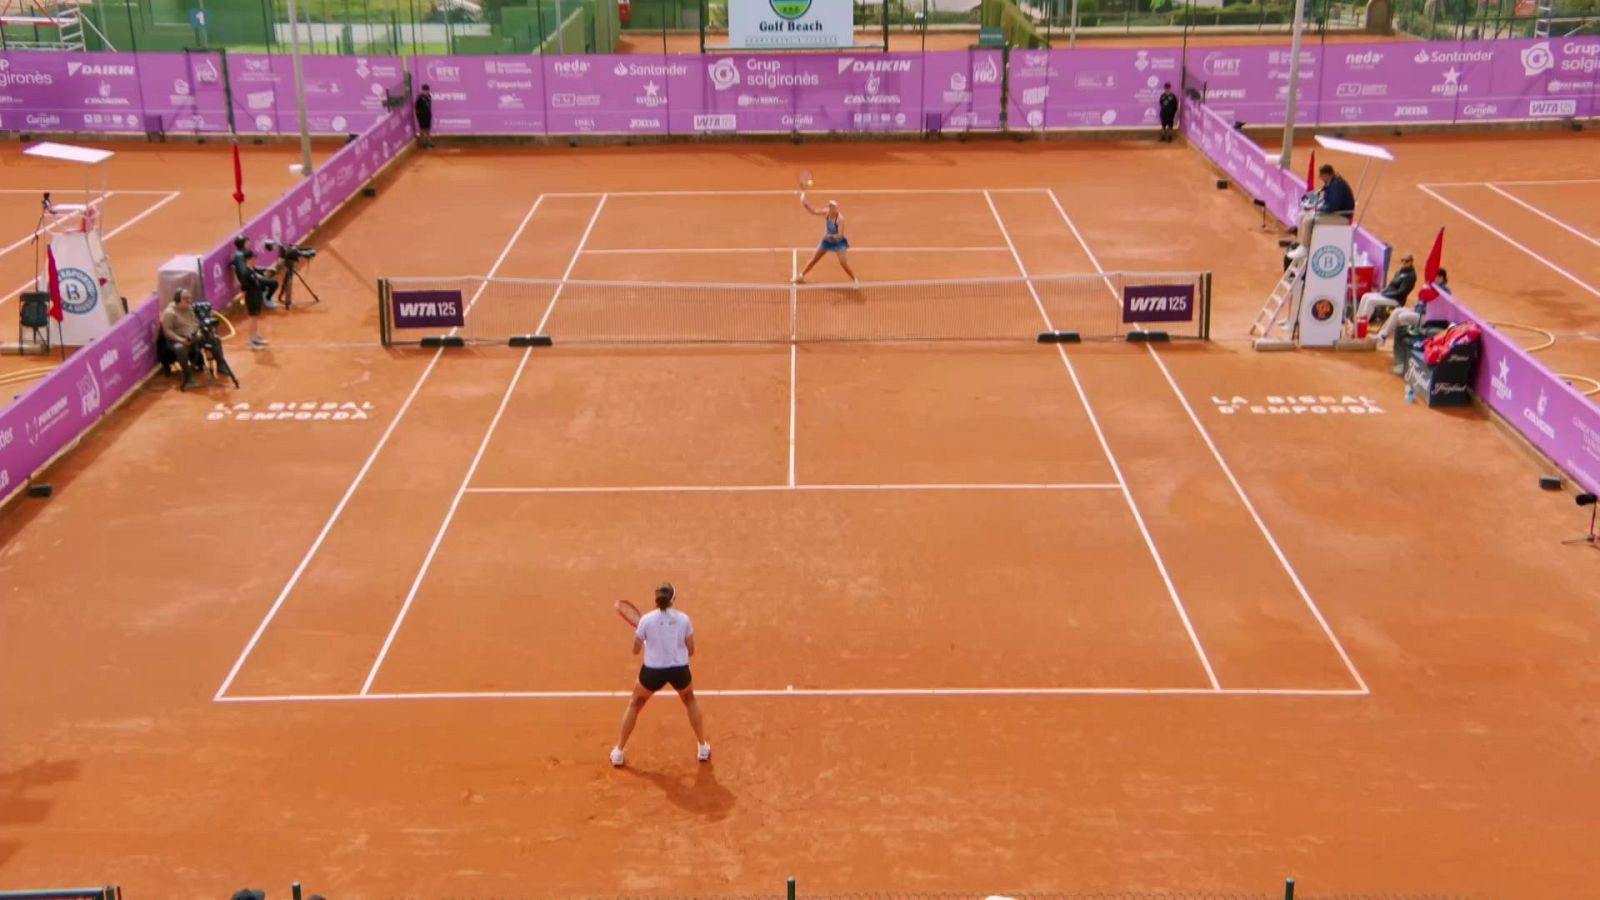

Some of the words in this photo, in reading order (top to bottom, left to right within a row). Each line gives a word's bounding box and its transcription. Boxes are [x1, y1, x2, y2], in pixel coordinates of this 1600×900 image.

[759, 21, 784, 32] Golf
[787, 20, 823, 32] Beach
[1563, 42, 1600, 56] Grup
[1431, 51, 1493, 63] Santander
[82, 65, 135, 75] DAIKIN
[629, 64, 687, 76] Santander
[747, 59, 780, 72] Grup
[853, 60, 912, 72] DAIKIN
[747, 72, 819, 88] solgironès
[1532, 103, 1558, 114] WTA
[400, 302, 437, 317] WTA
[437, 302, 456, 317] 125
[1130, 297, 1167, 312] WTA
[1168, 296, 1187, 311] 125
